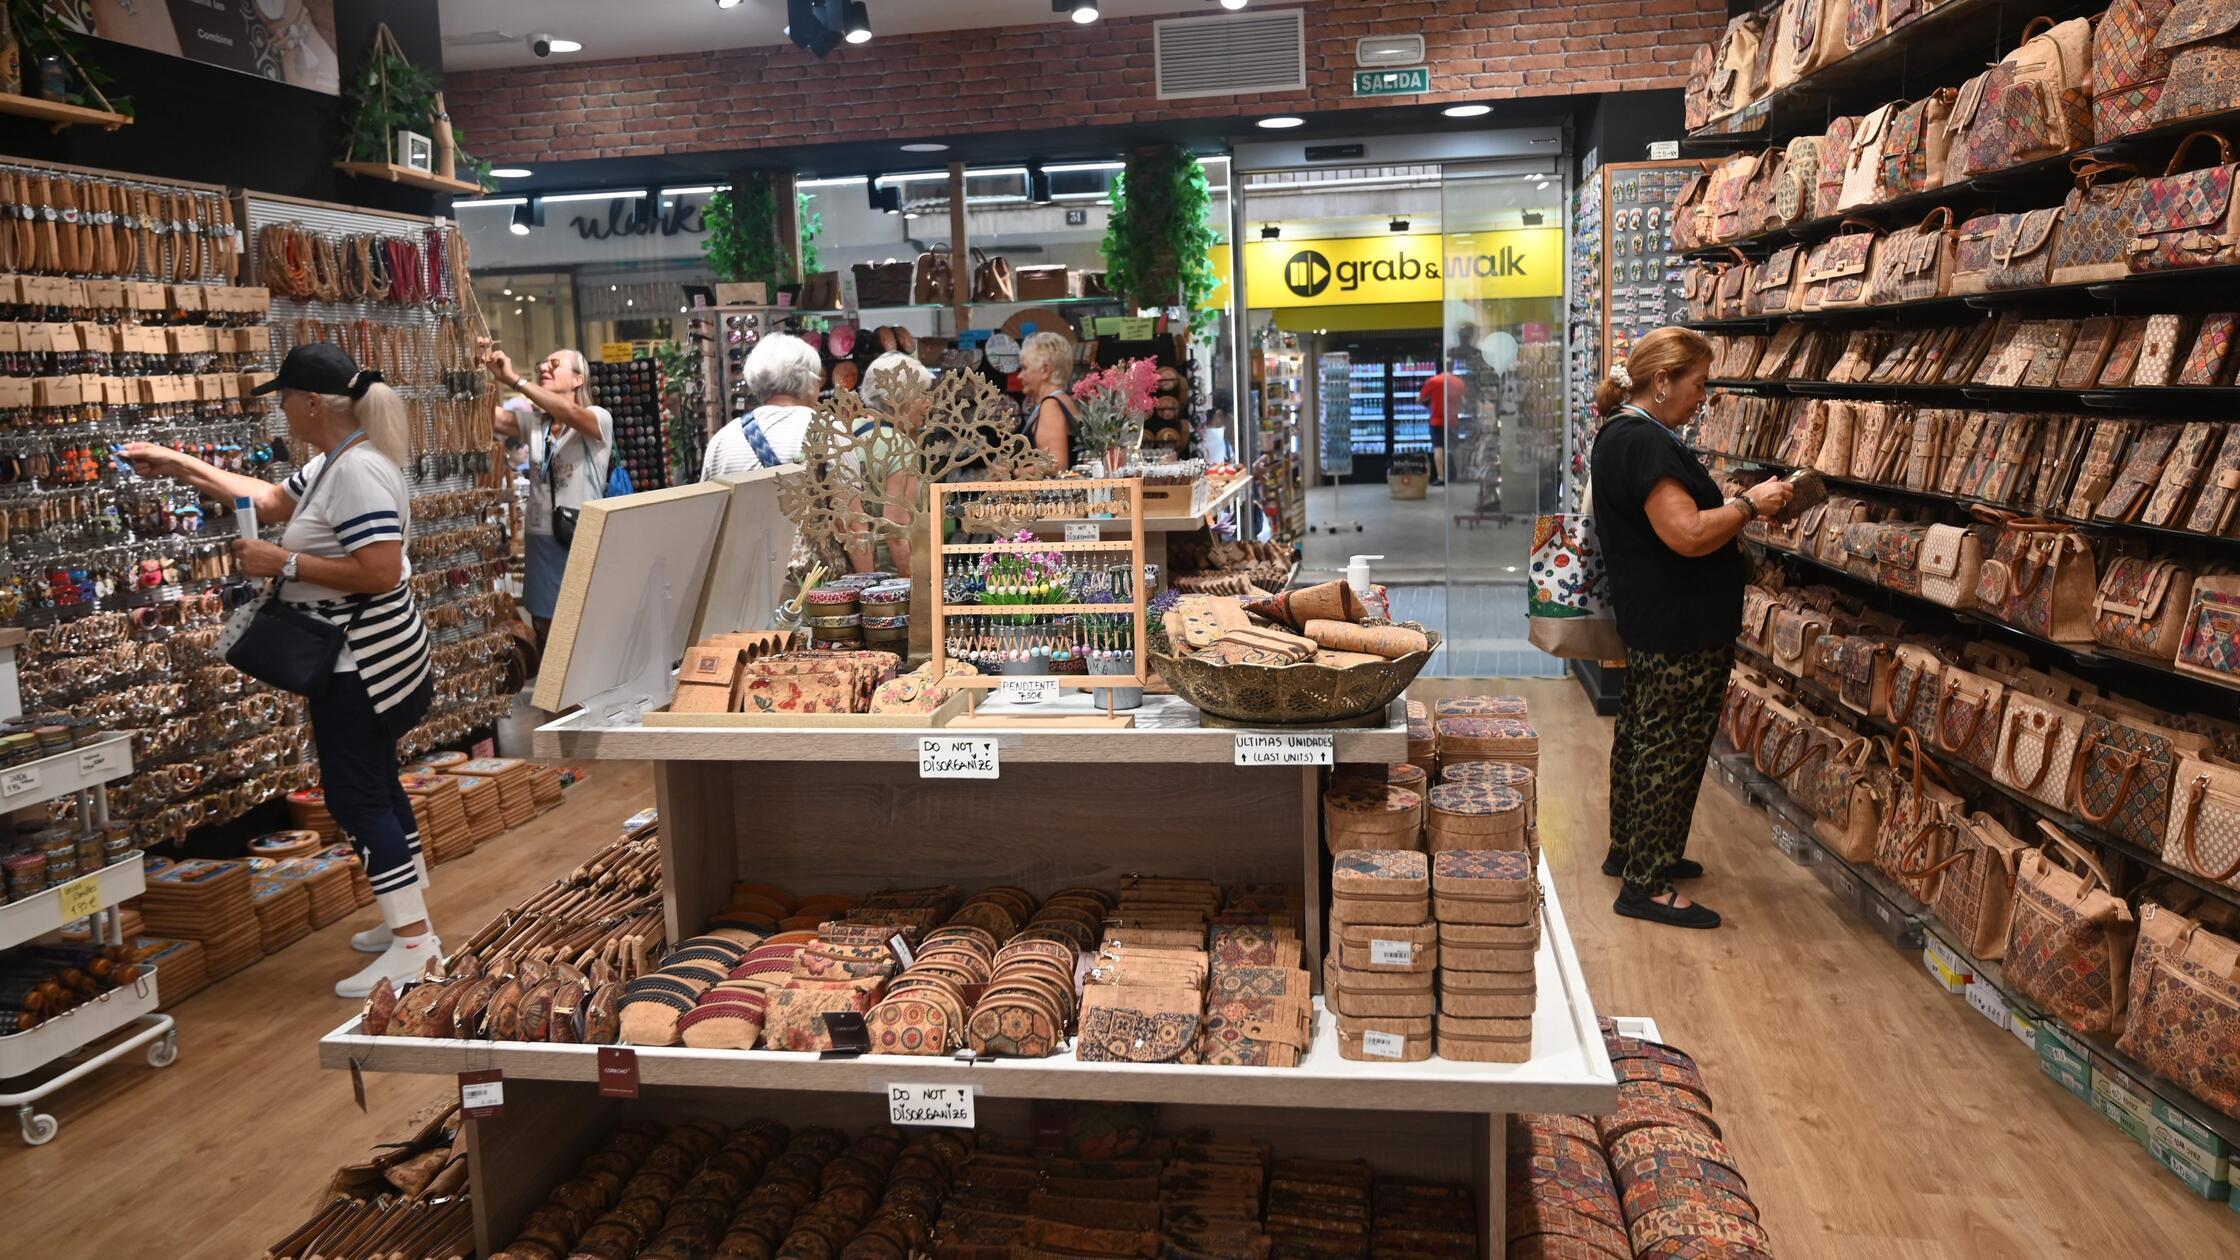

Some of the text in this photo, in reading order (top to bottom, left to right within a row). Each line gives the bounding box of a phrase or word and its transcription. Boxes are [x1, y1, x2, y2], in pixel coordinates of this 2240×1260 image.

[197, 28, 234, 46] Combine
[1361, 72, 1422, 90] SALIDA
[1336, 246, 1527, 291] grab & walk
[1002, 681, 1057, 692] PENDIENTE
[924, 741, 941, 752] DO
[952, 742, 974, 754] NOT
[1236, 736, 1333, 748] ULTIMAS UNIDADES
[893, 1088, 910, 1101] DO
[923, 1088, 946, 1100] NOT
